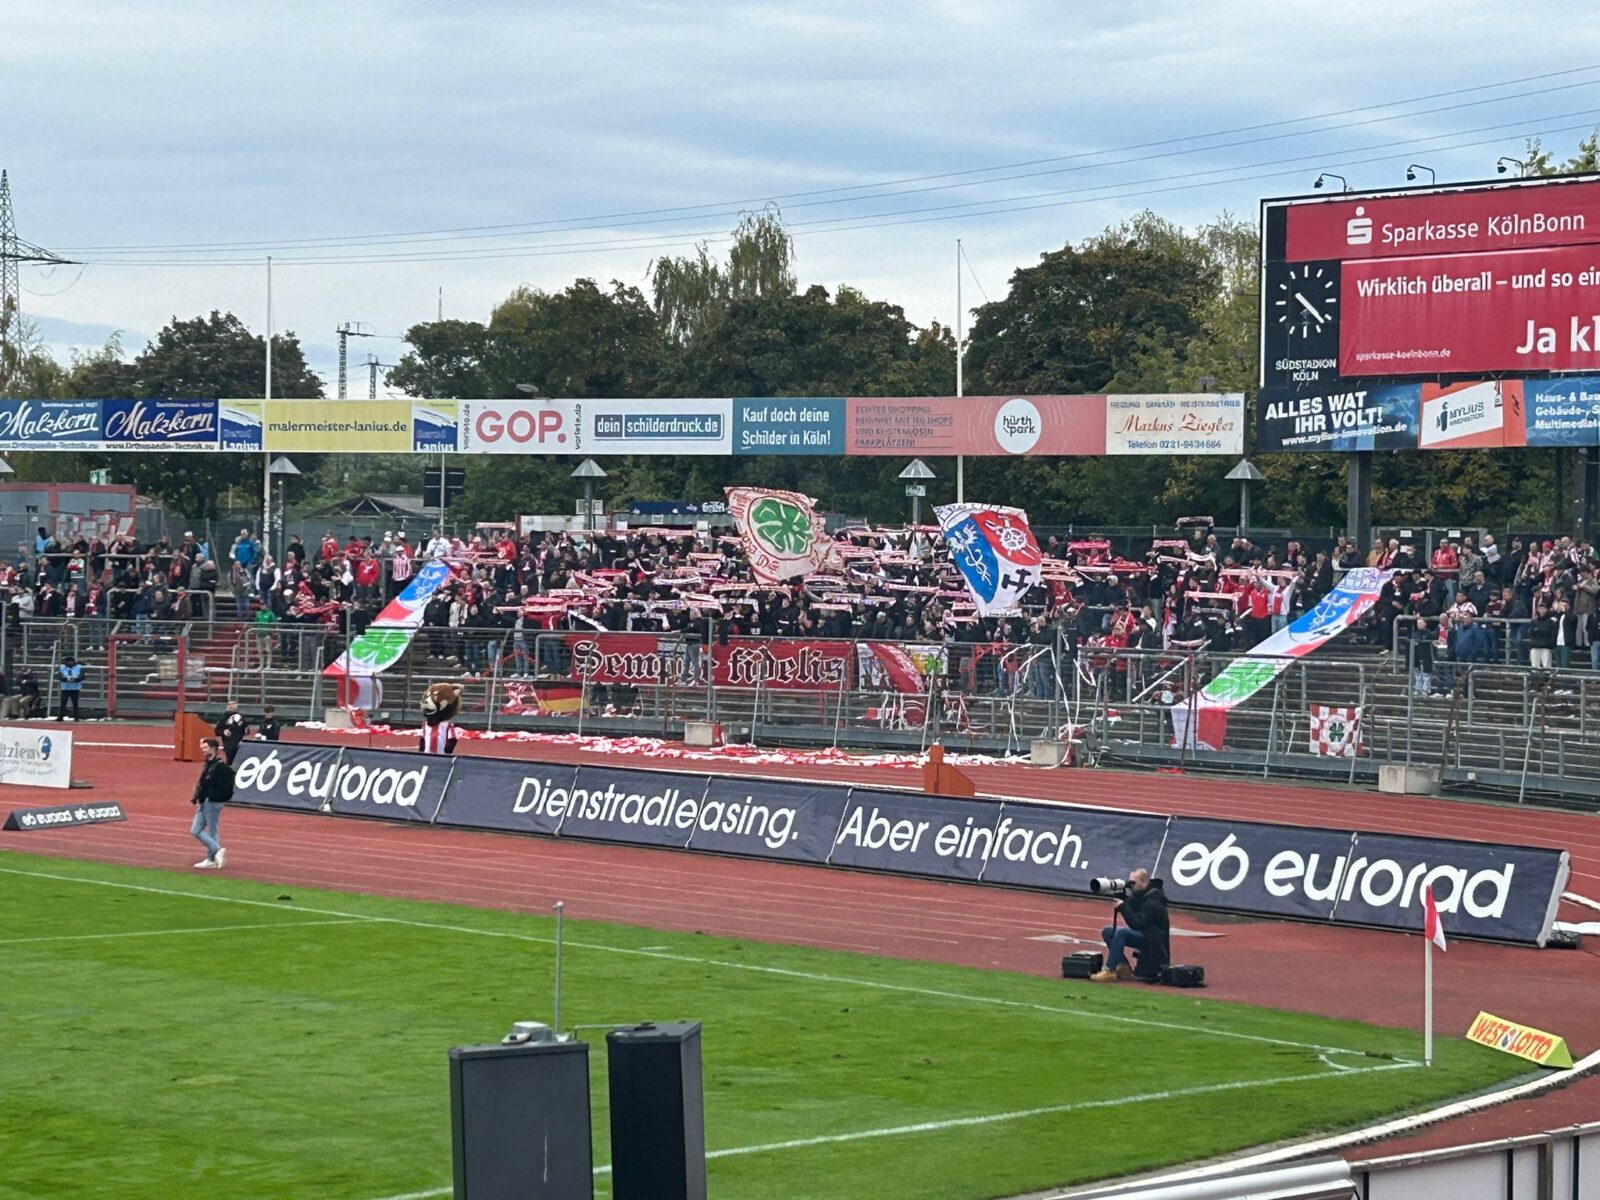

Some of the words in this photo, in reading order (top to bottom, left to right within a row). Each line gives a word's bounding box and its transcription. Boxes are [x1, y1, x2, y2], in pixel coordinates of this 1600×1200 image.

[1382, 218, 1478, 247] Sparkasse
[1488, 213, 1584, 236] KölnBonn
[1357, 276, 1427, 297] Wirklich
[1432, 271, 1492, 293] überall
[1512, 268, 1546, 289] und
[1551, 272, 1573, 288] so
[1578, 266, 1600, 286] ei
[1516, 319, 1556, 354] Ja
[1275, 357, 1337, 370] SÜDSTADION
[1356, 347, 1451, 362] sparkasse-koelnbonn.de
[1293, 369, 1319, 381] KÖLN
[743, 406, 768, 422] Kauf
[770, 406, 796, 422] doch
[799, 406, 830, 422] deine
[1265, 397, 1323, 420] ALLES
[1328, 391, 1367, 412] WAT
[1449, 401, 1484, 419] MYLIUS
[0, 401, 98, 439] Malzkorn
[105, 401, 215, 439] Malzkorn
[268, 420, 407, 433] malermeister-lanius.de
[475, 410, 566, 443] GOP.
[597, 417, 620, 433] dein
[626, 416, 718, 433] schilderdruck.de
[1003, 415, 1032, 426] hürth
[1009, 425, 1035, 437] park
[1178, 413, 1235, 436] Ziegler
[1295, 414, 1327, 434] IHR
[1331, 406, 1383, 429] VOLT!
[416, 441, 454, 451] Lanius
[742, 430, 787, 446] Schilder
[789, 430, 800, 446] in
[803, 429, 831, 446] Köln!
[1128, 440, 1158, 449] Telefon
[573, 640, 720, 686] Sempr
[287, 758, 428, 807] eurorad
[513, 776, 800, 849] Dienstradleasing.
[836, 806, 929, 852] Aber
[934, 816, 1090, 870] einfach.
[1264, 849, 1516, 919] eurorad
[1473, 1017, 1510, 1046] WEST
[1508, 1030, 1554, 1061] LOTTO
